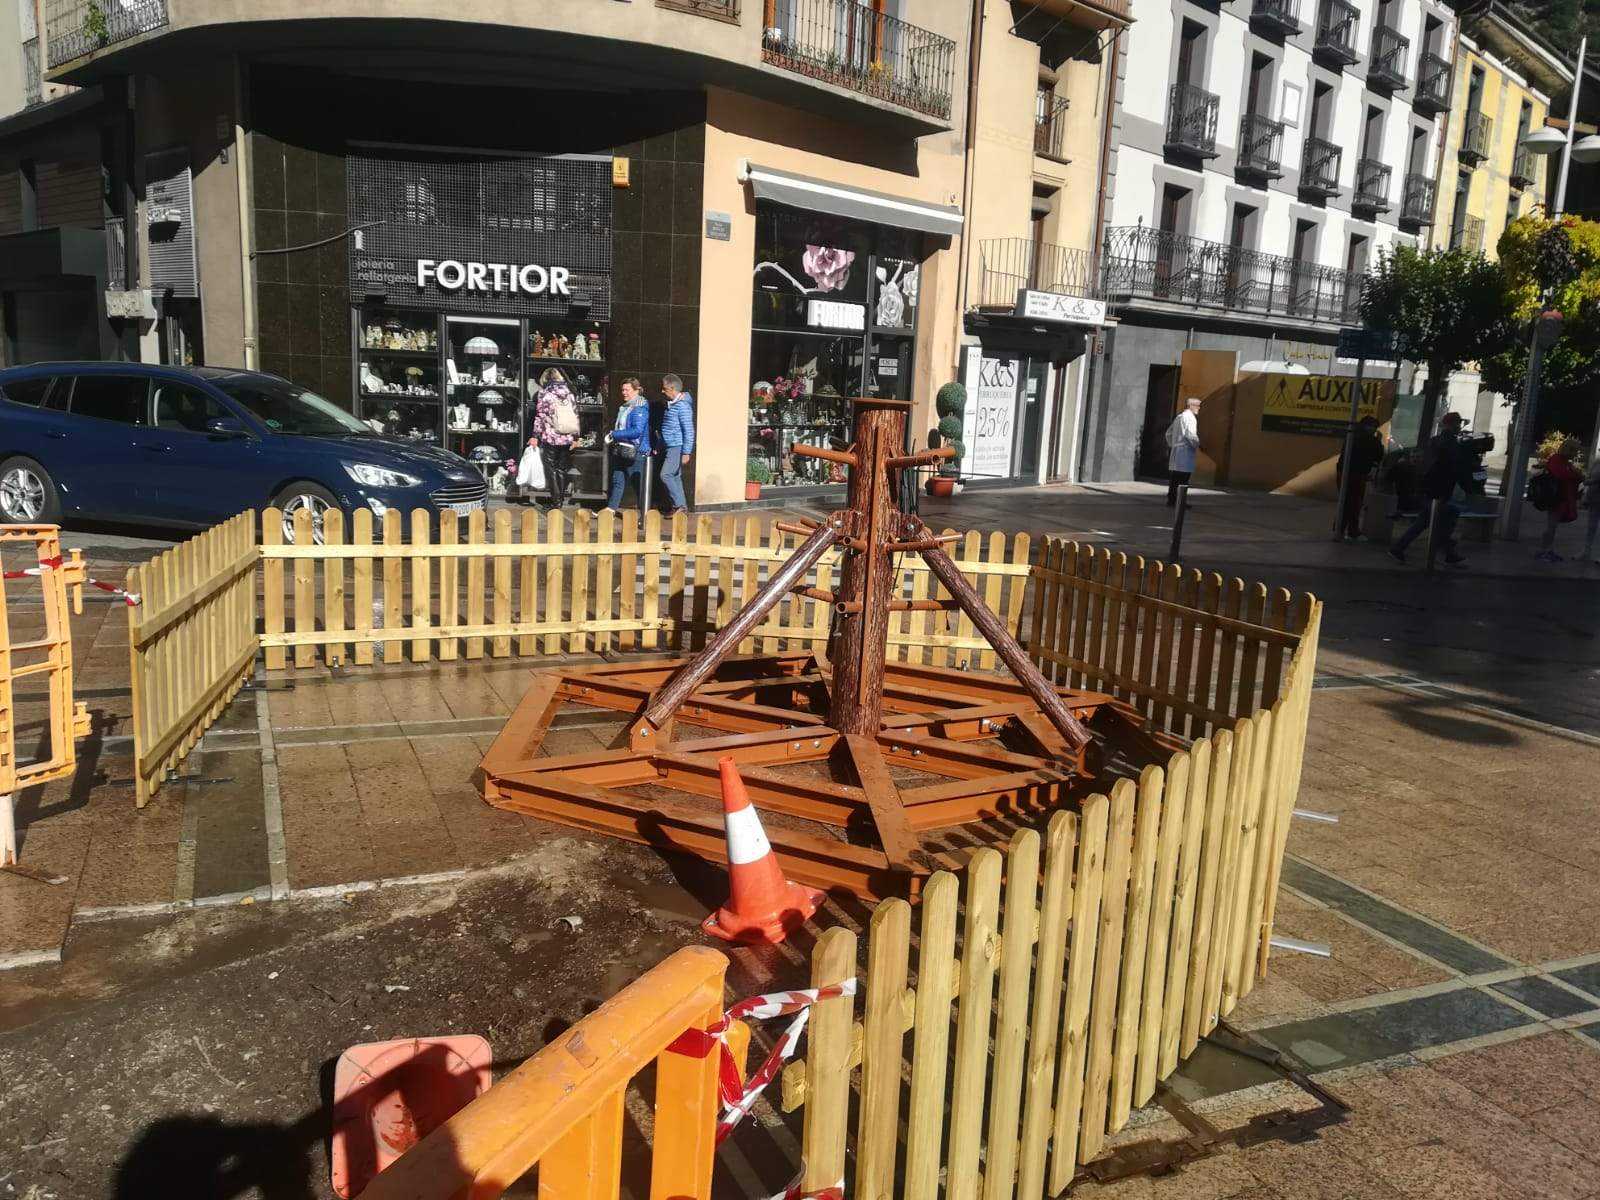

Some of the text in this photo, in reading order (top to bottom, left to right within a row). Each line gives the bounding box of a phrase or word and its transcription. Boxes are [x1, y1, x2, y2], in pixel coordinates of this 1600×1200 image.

[417, 259, 571, 295] FORTIOR
[1052, 296, 1069, 312] K
[1090, 302, 1104, 316] S
[1298, 378, 1378, 406] AUXINI
[979, 406, 1009, 438] 25%
